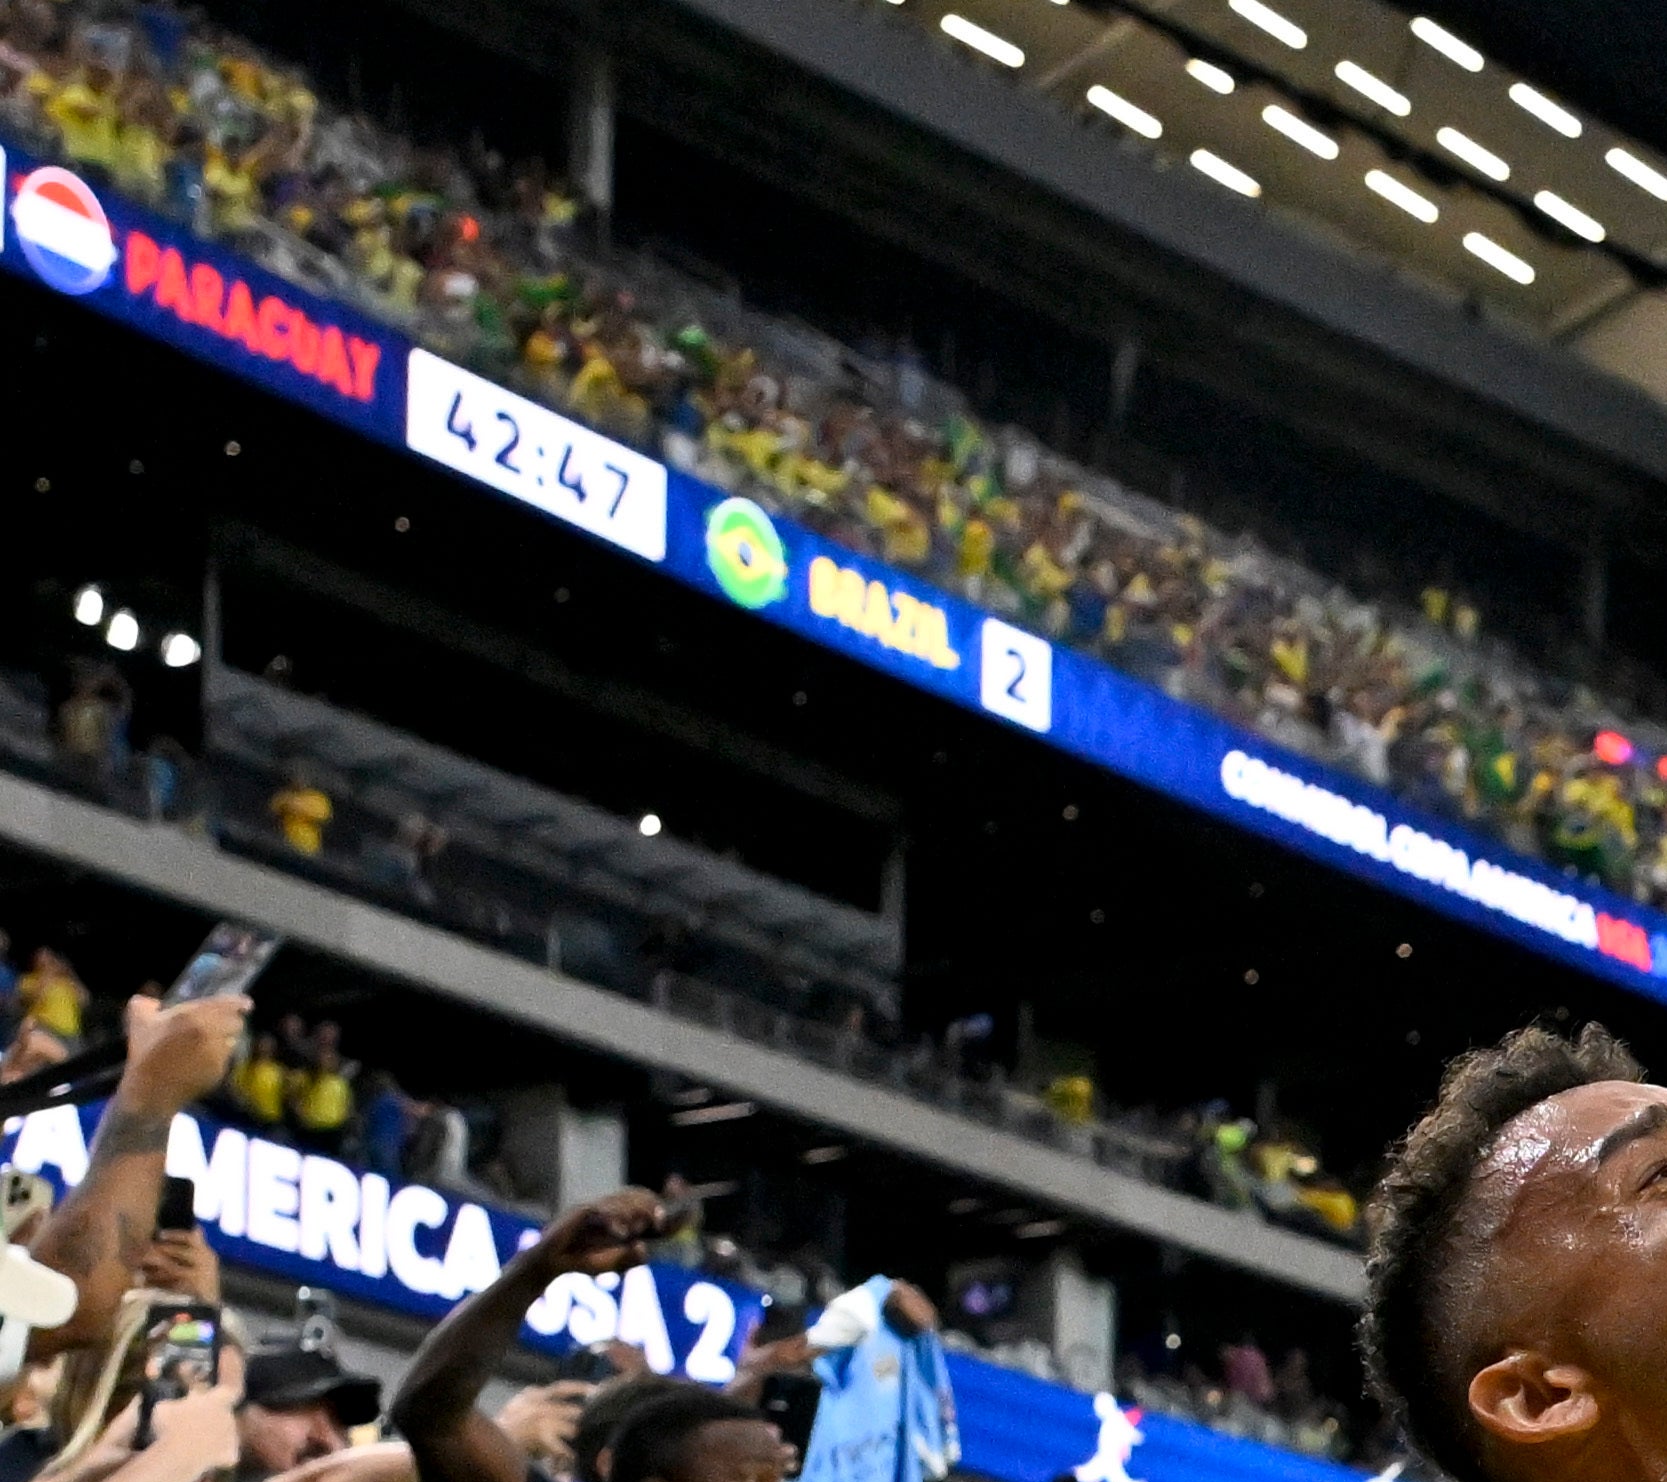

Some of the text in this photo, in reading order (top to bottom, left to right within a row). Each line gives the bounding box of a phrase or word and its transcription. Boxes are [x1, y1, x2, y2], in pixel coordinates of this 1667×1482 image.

[124, 229, 381, 402] PARAGUAY
[446, 390, 631, 519] 42:47
[1006, 647, 1028, 703] 2
